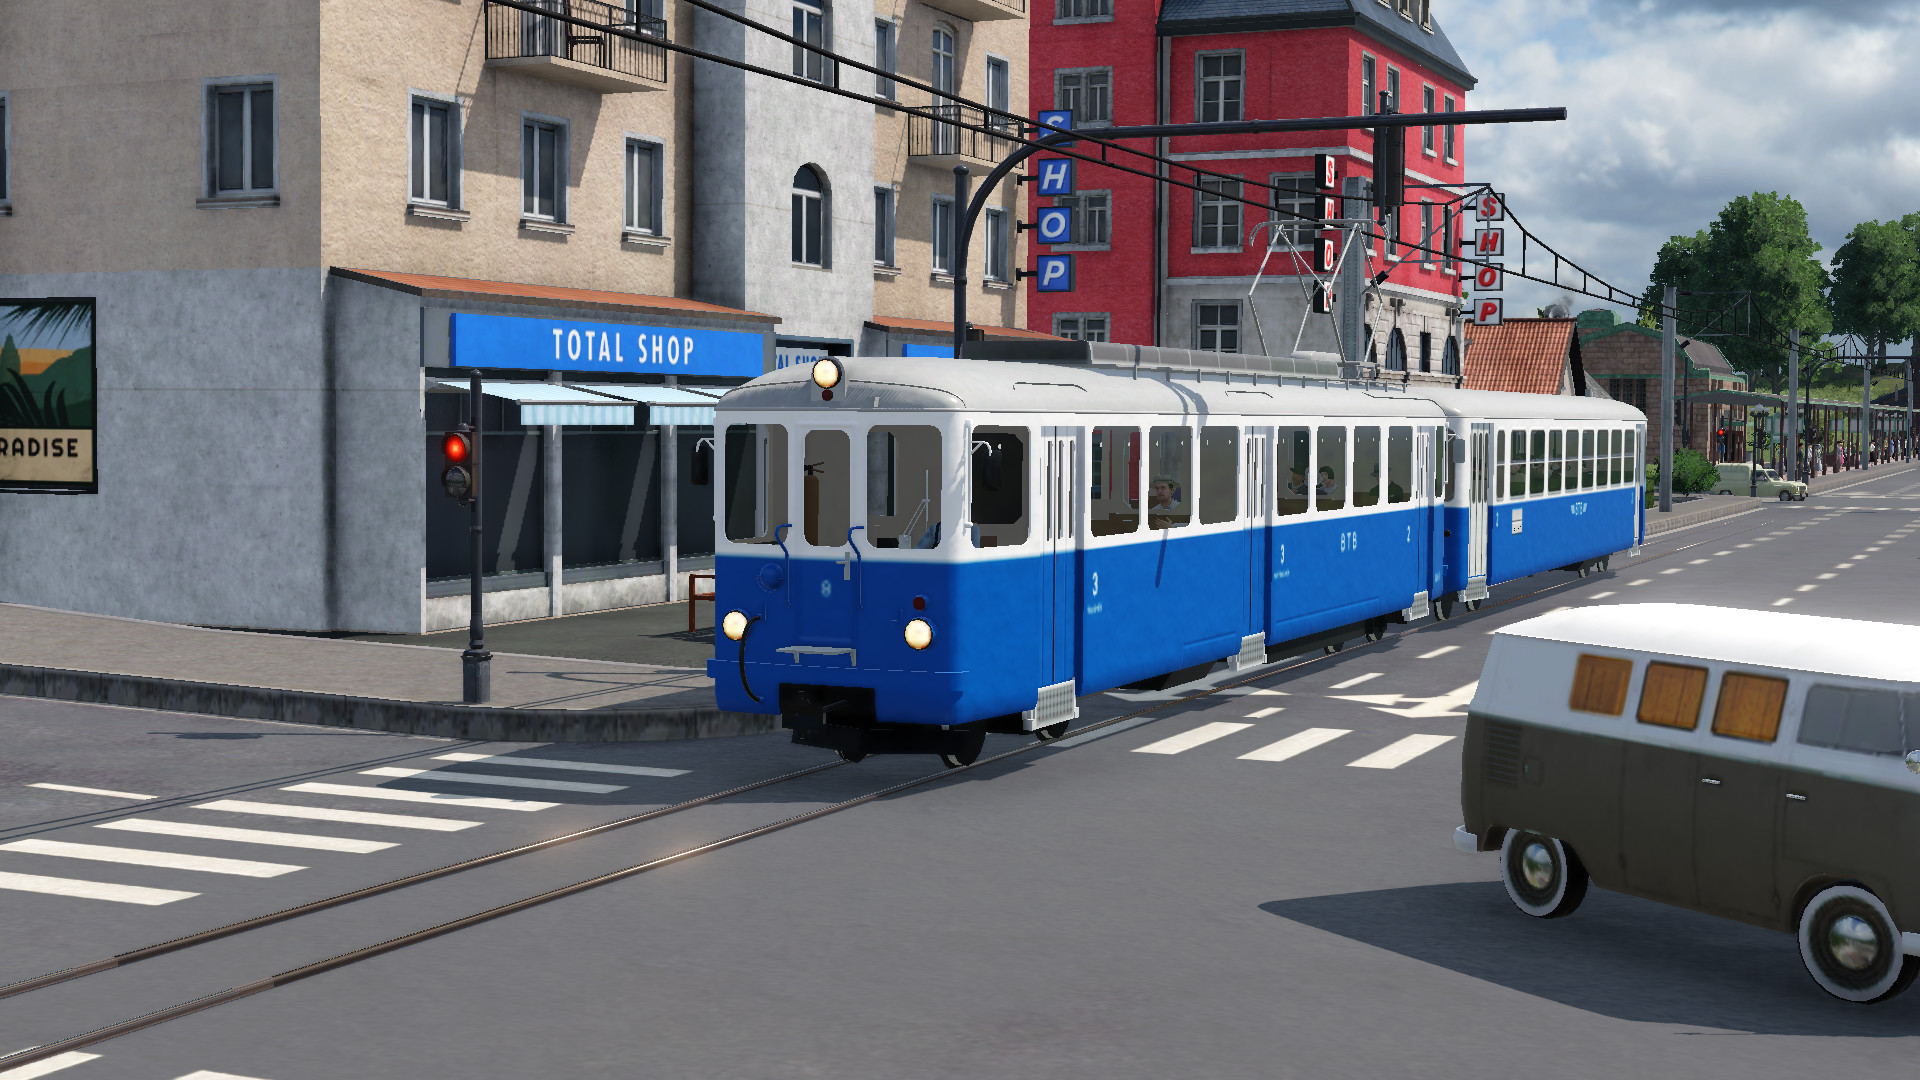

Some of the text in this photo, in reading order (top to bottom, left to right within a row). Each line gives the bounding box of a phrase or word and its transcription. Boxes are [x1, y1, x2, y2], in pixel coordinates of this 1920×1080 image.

[1478, 197, 1499, 321] SHOP
[553, 328, 694, 366] TOTAL SHOP
[1340, 531, 1358, 553] BTB
[1406, 525, 1411, 543] 2
[1280, 543, 1285, 564] 3
[821, 579, 832, 598] 8
[1092, 571, 1099, 597] 3
